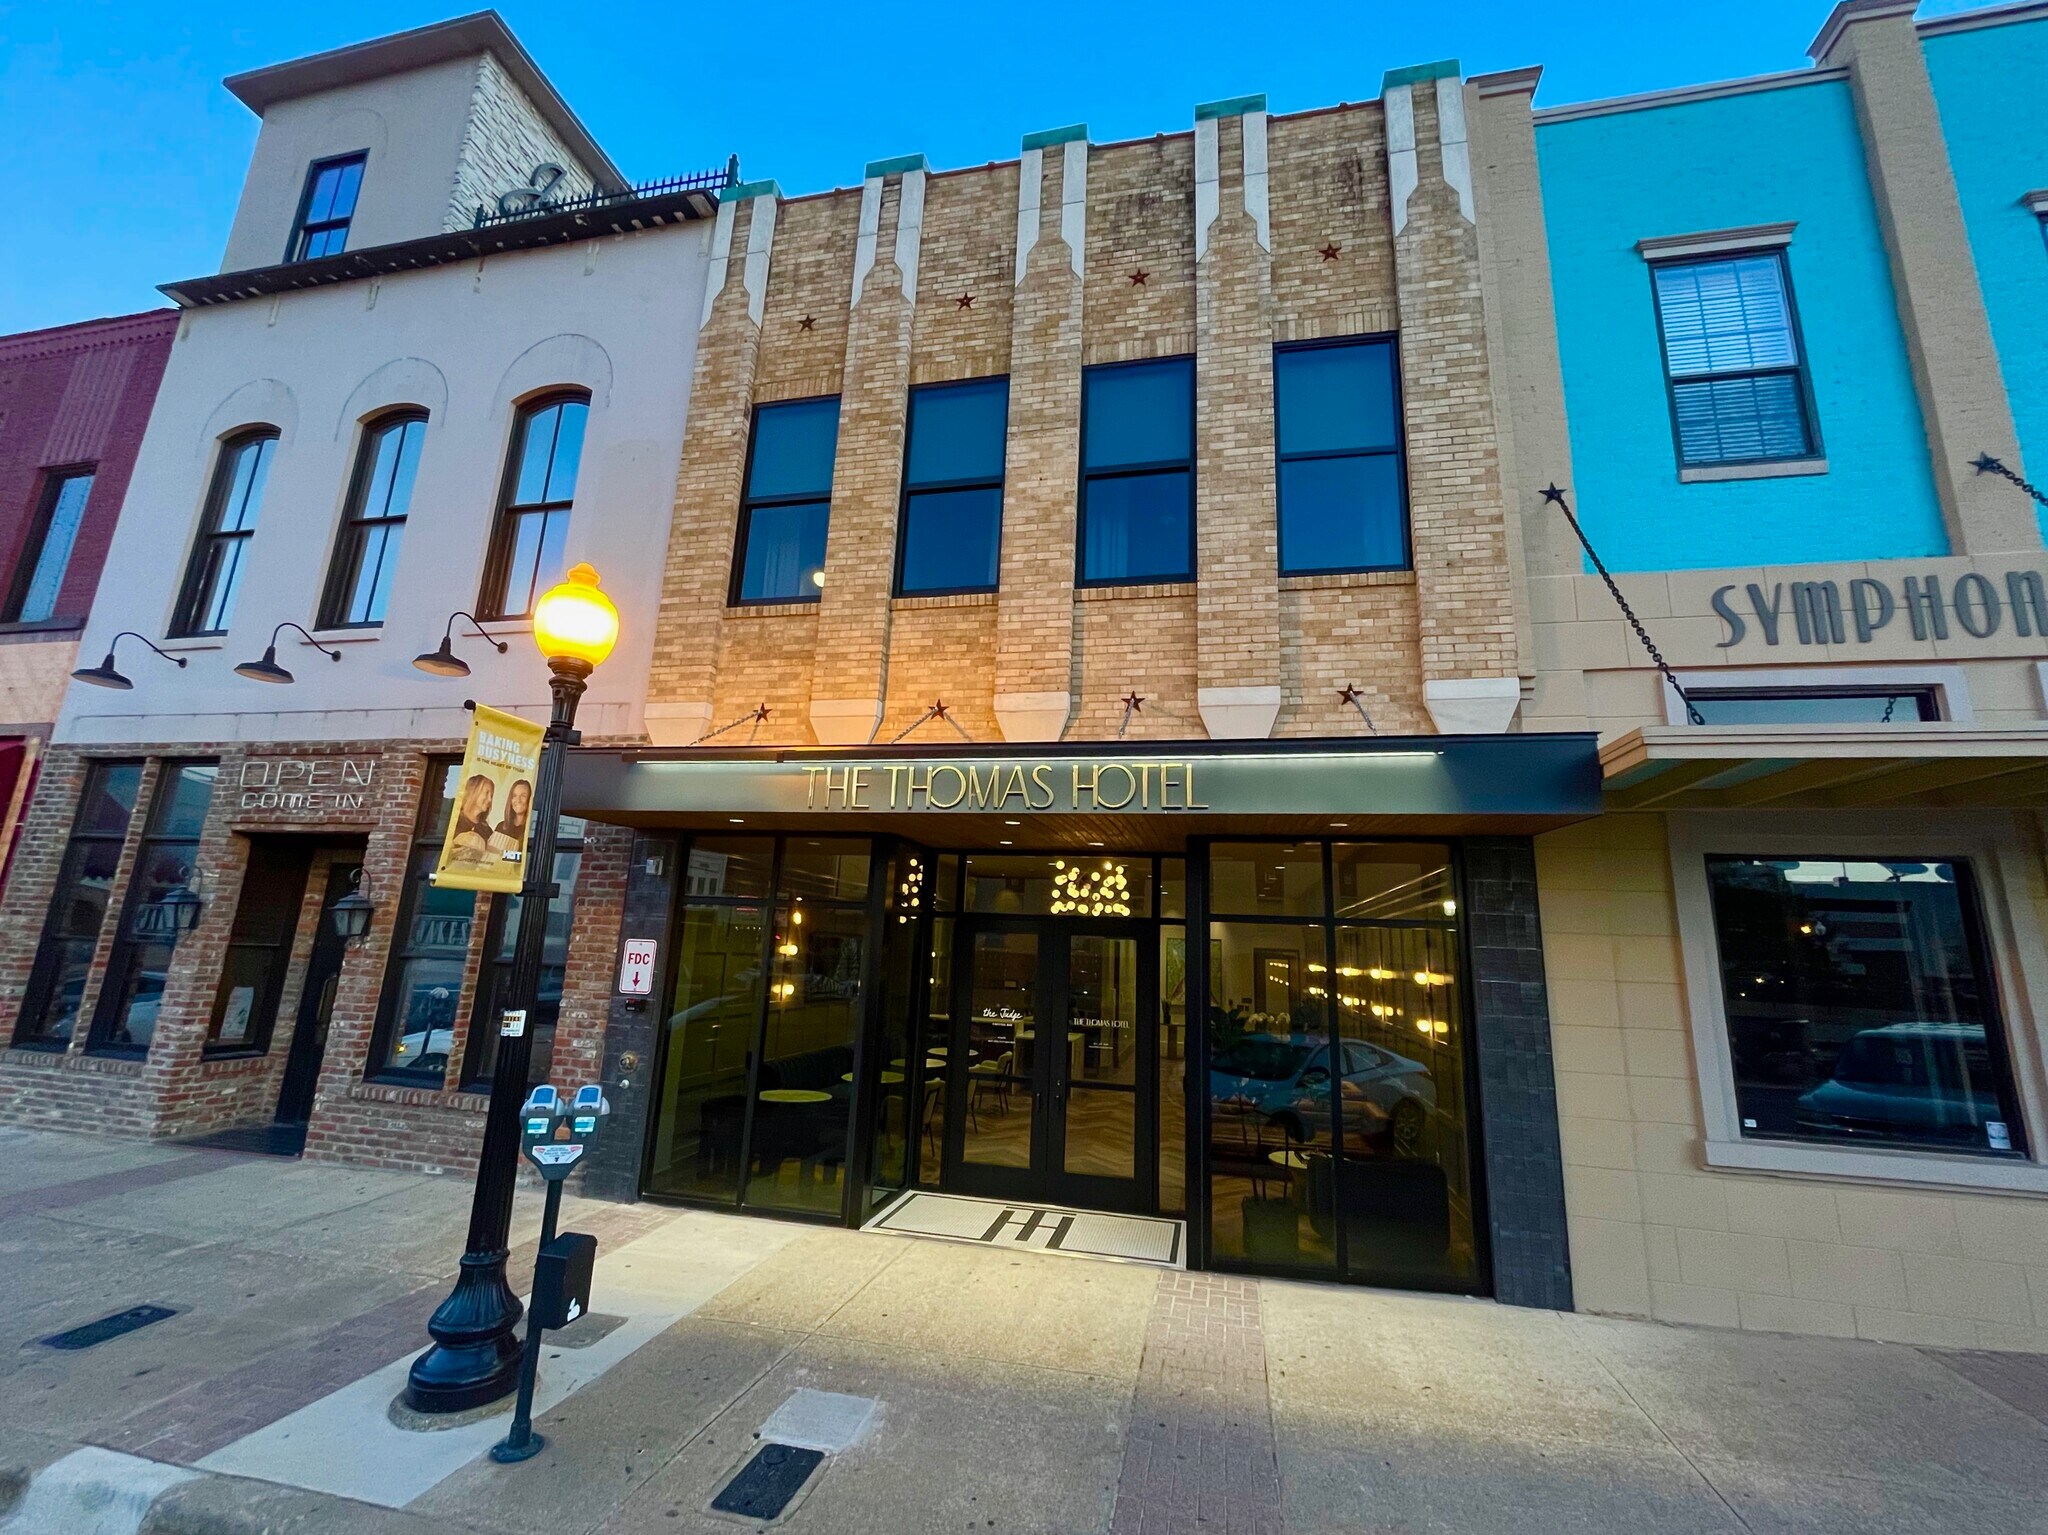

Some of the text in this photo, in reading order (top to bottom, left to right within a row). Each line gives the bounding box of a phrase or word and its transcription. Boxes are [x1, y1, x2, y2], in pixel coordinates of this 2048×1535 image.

[478, 731, 521, 754] BAKING
[477, 743, 535, 770] BUSYNESS
[240, 759, 376, 788] OPEN
[801, 763, 1210, 809] THE THOMAS HOTEL
[241, 792, 364, 809] COME IN
[628, 953, 651, 966] FDC
[983, 1008, 1023, 1021] the Judge
[1073, 1017, 1130, 1029] THE THOMAS HOTEL
